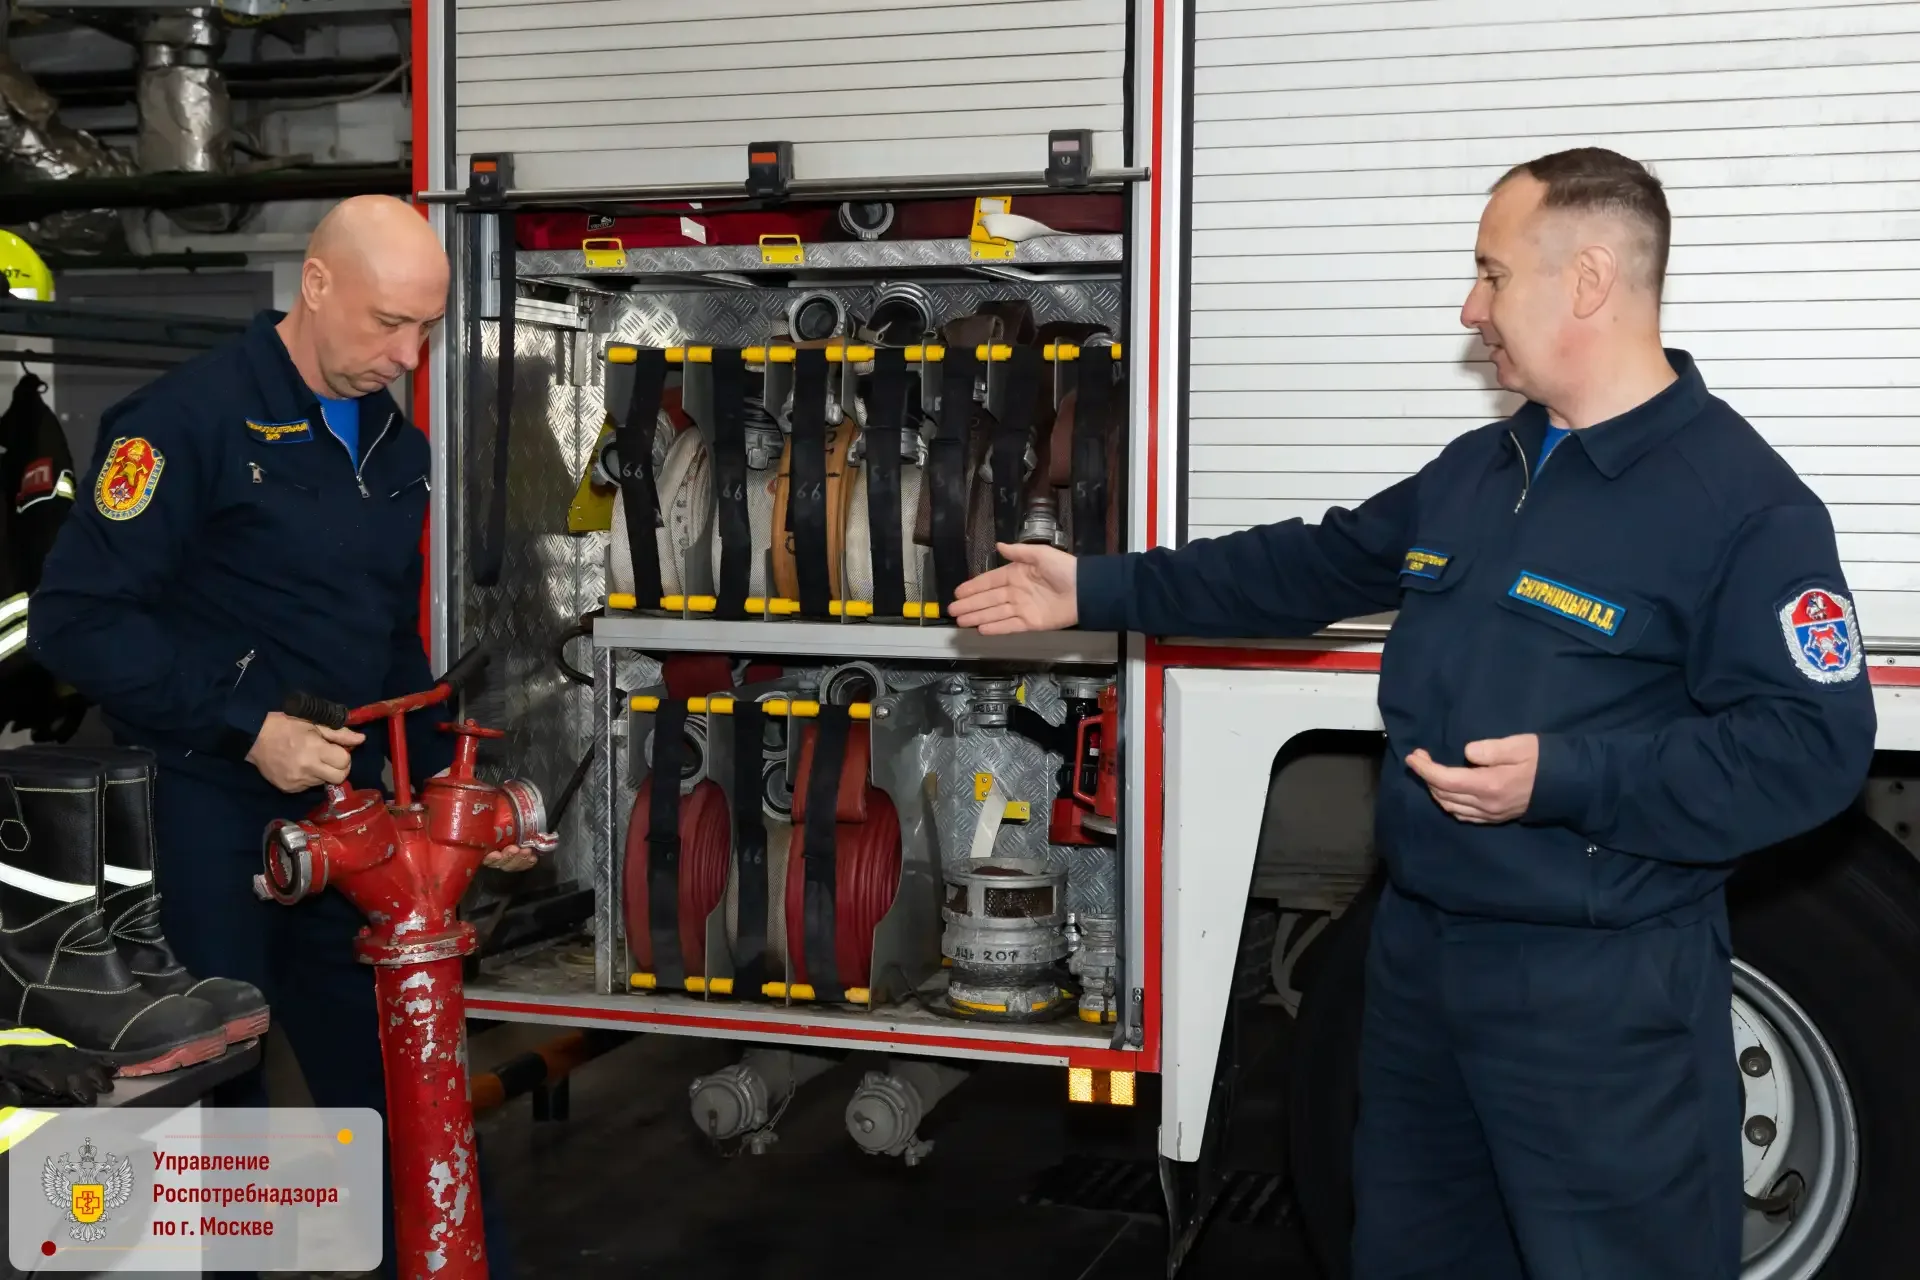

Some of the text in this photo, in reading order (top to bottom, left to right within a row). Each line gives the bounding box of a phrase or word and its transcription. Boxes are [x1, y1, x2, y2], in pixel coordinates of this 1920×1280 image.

[622, 462, 644, 479] 66
[723, 484, 742, 500] 66
[797, 482, 821, 500] 66
[1000, 487, 1018, 507] 51
[984, 950, 1018, 962] 207
